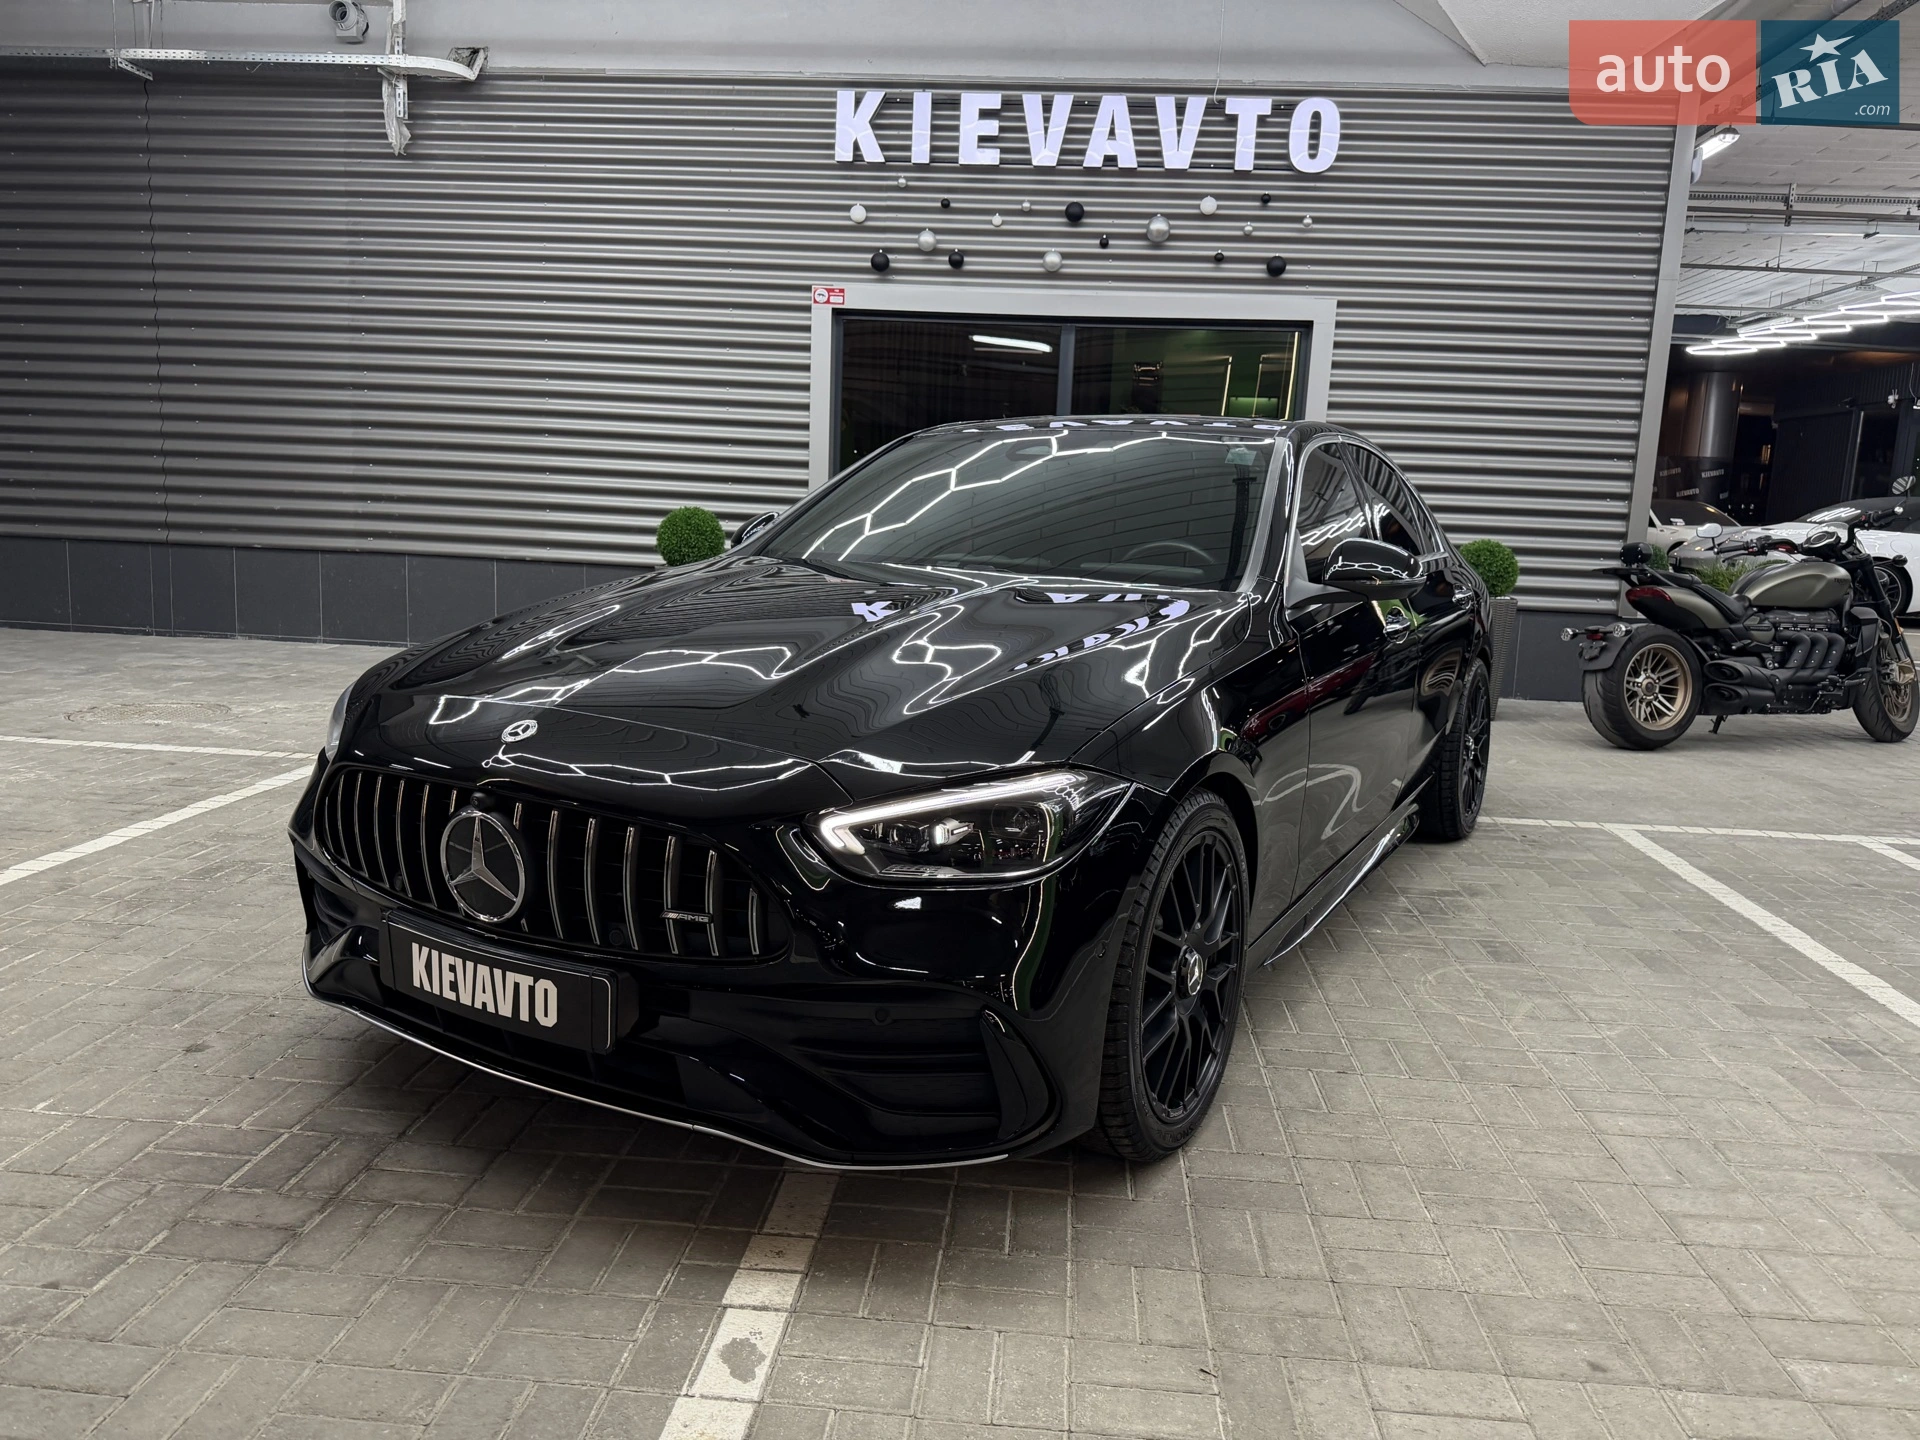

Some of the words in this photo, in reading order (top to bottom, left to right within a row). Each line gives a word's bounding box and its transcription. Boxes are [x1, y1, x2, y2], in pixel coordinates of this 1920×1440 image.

[834, 90, 1342, 174] KIEVAVTO
[677, 913, 709, 922] AMG
[411, 942, 558, 1028] KIEVAVTO
